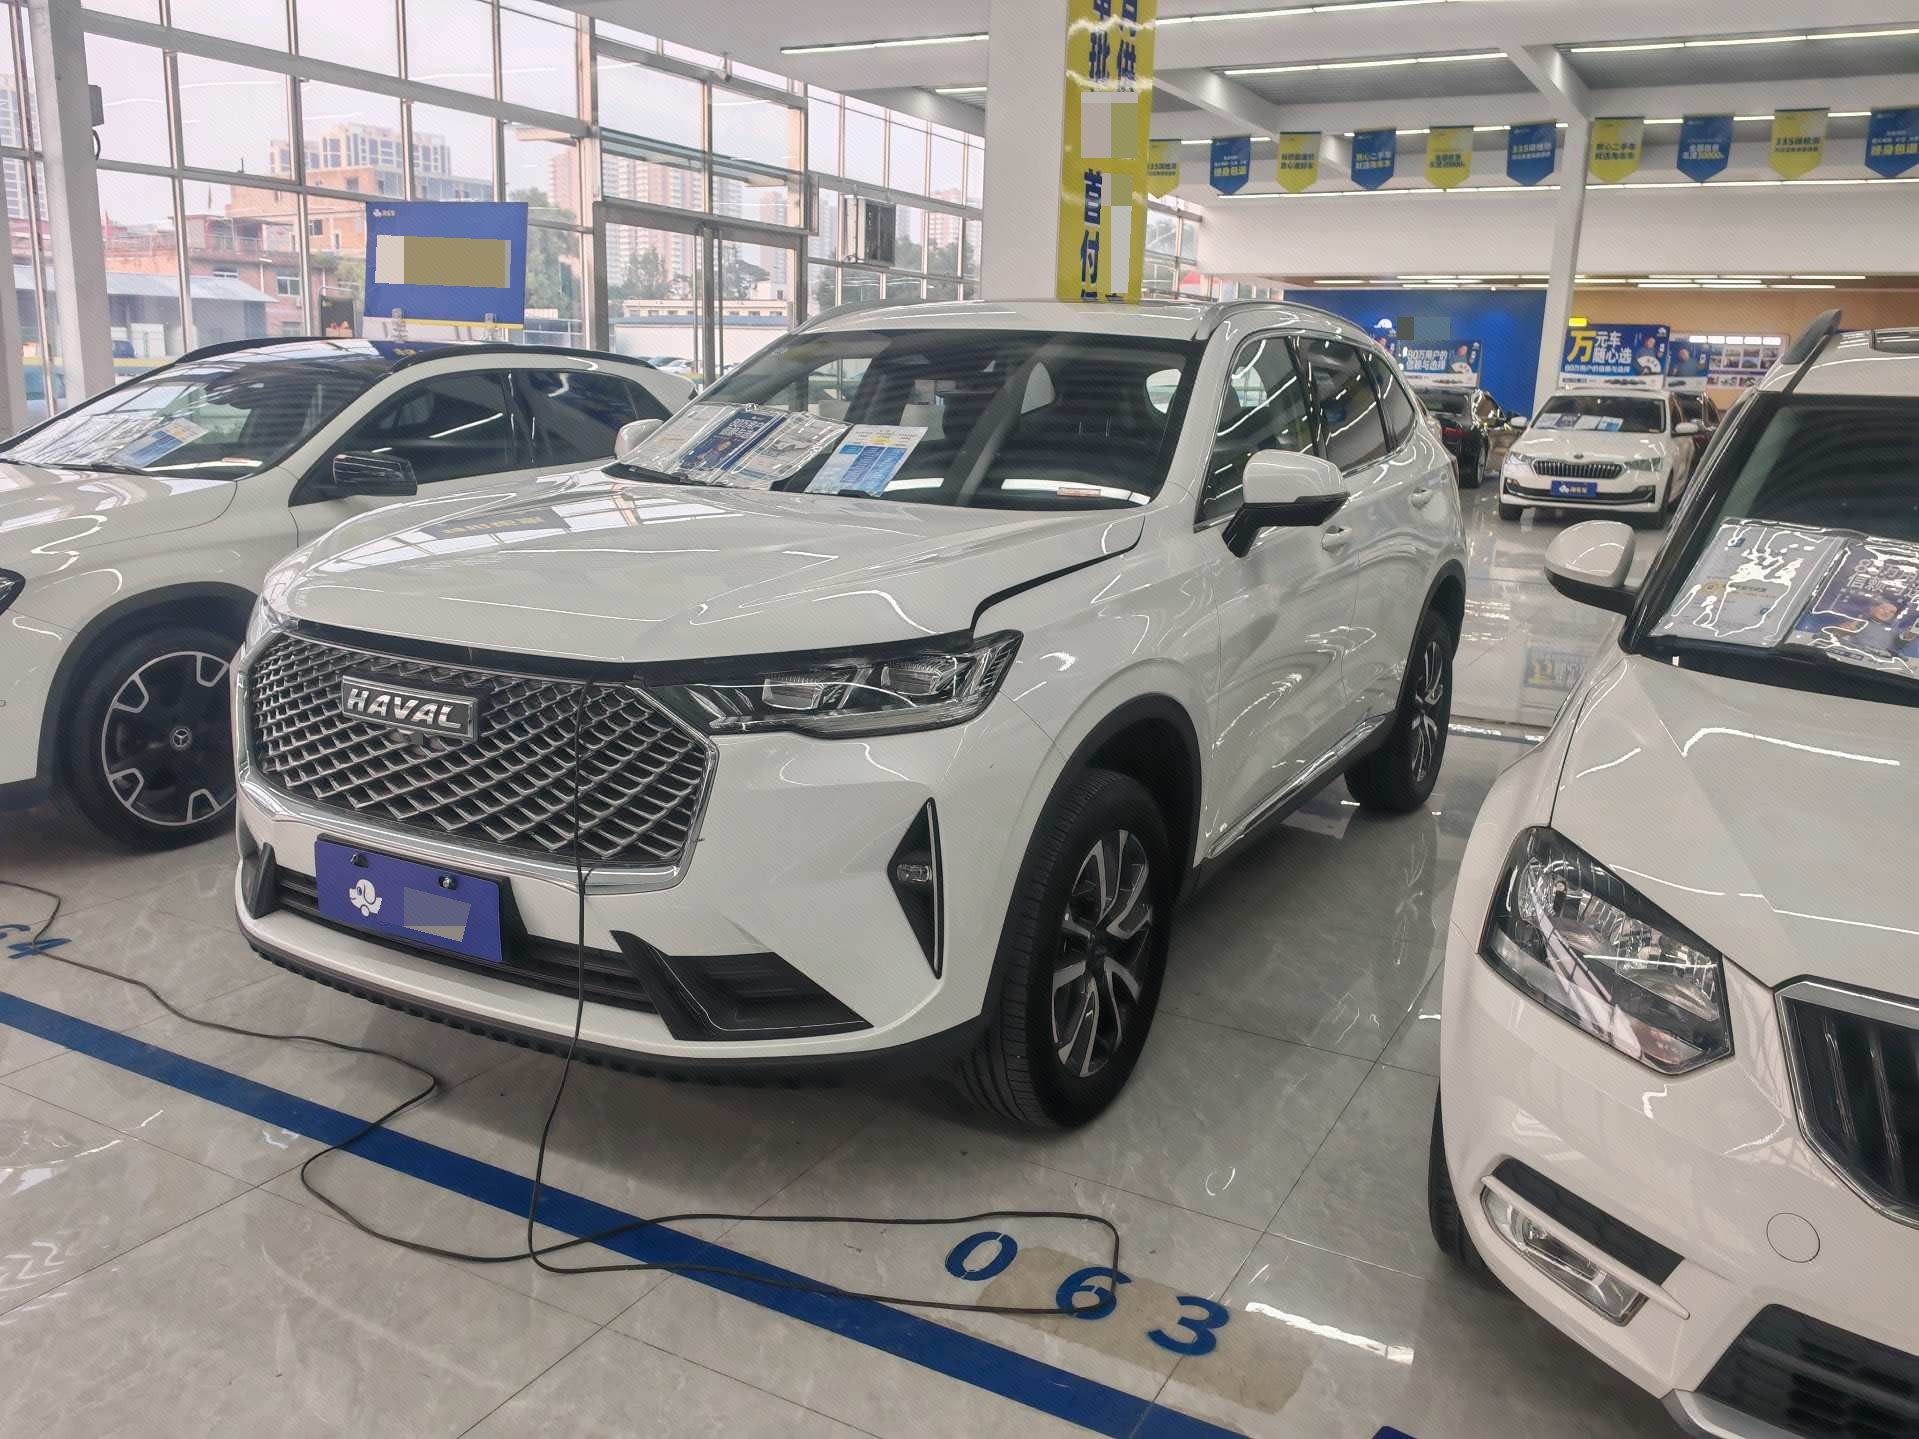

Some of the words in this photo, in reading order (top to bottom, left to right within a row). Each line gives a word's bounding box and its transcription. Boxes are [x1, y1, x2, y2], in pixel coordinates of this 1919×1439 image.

[1567, 330, 1597, 363] 万
[1592, 346, 1632, 364] 随心选
[1594, 331, 1622, 348] 元车
[347, 688, 462, 729] HAVAL
[944, 1230, 1231, 1357] 063
